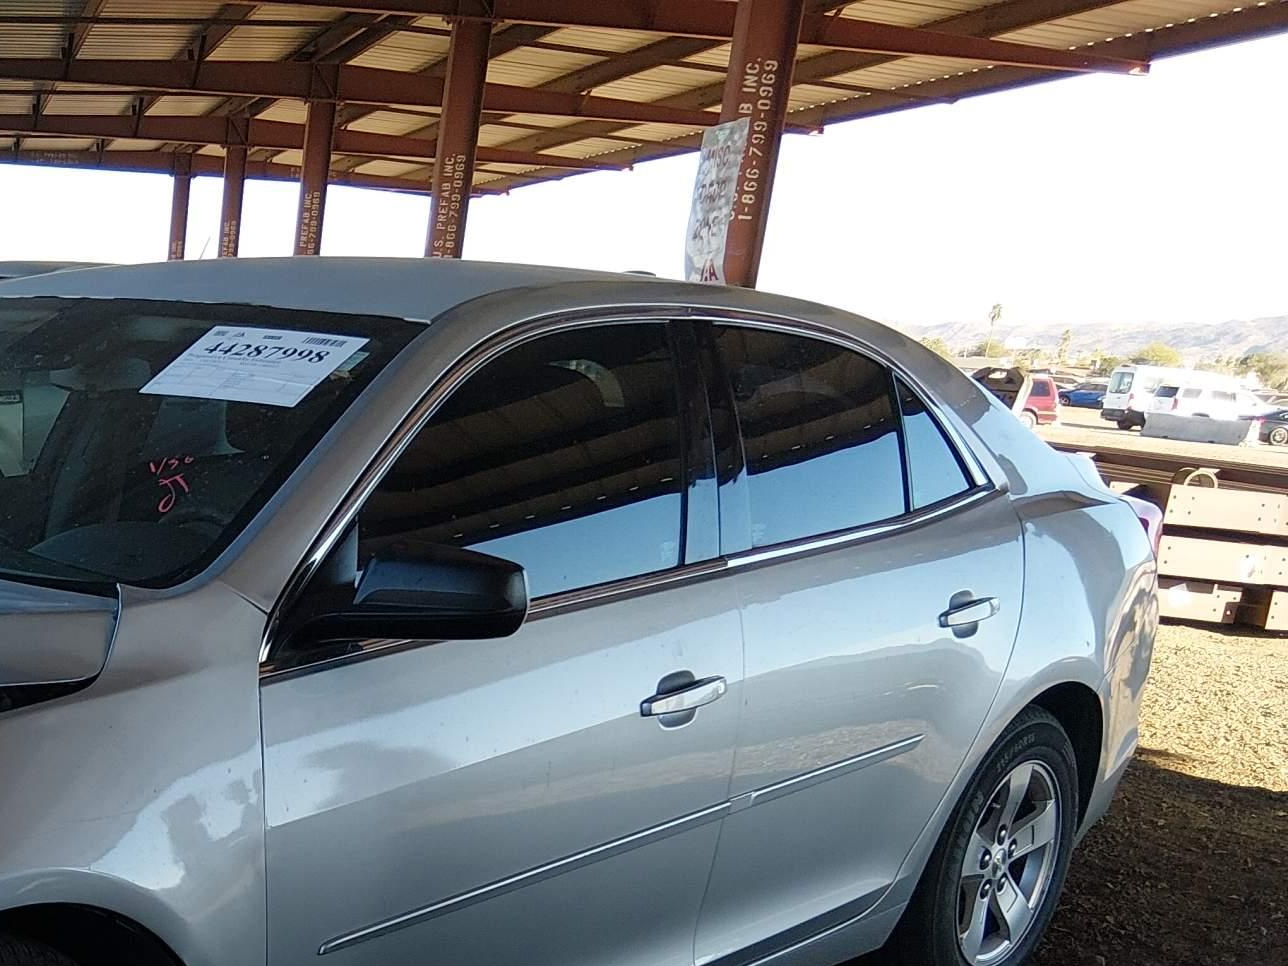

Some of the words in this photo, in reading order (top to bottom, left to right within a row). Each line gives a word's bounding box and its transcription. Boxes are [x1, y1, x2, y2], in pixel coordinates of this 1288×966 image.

[737, 60, 778, 220] 1-866-799-0969
[443, 153, 456, 177] INC.
[436, 182, 451, 230] PREFAB
[299, 212, 311, 248] PREFAB
[203, 341, 331, 365] 44287998
